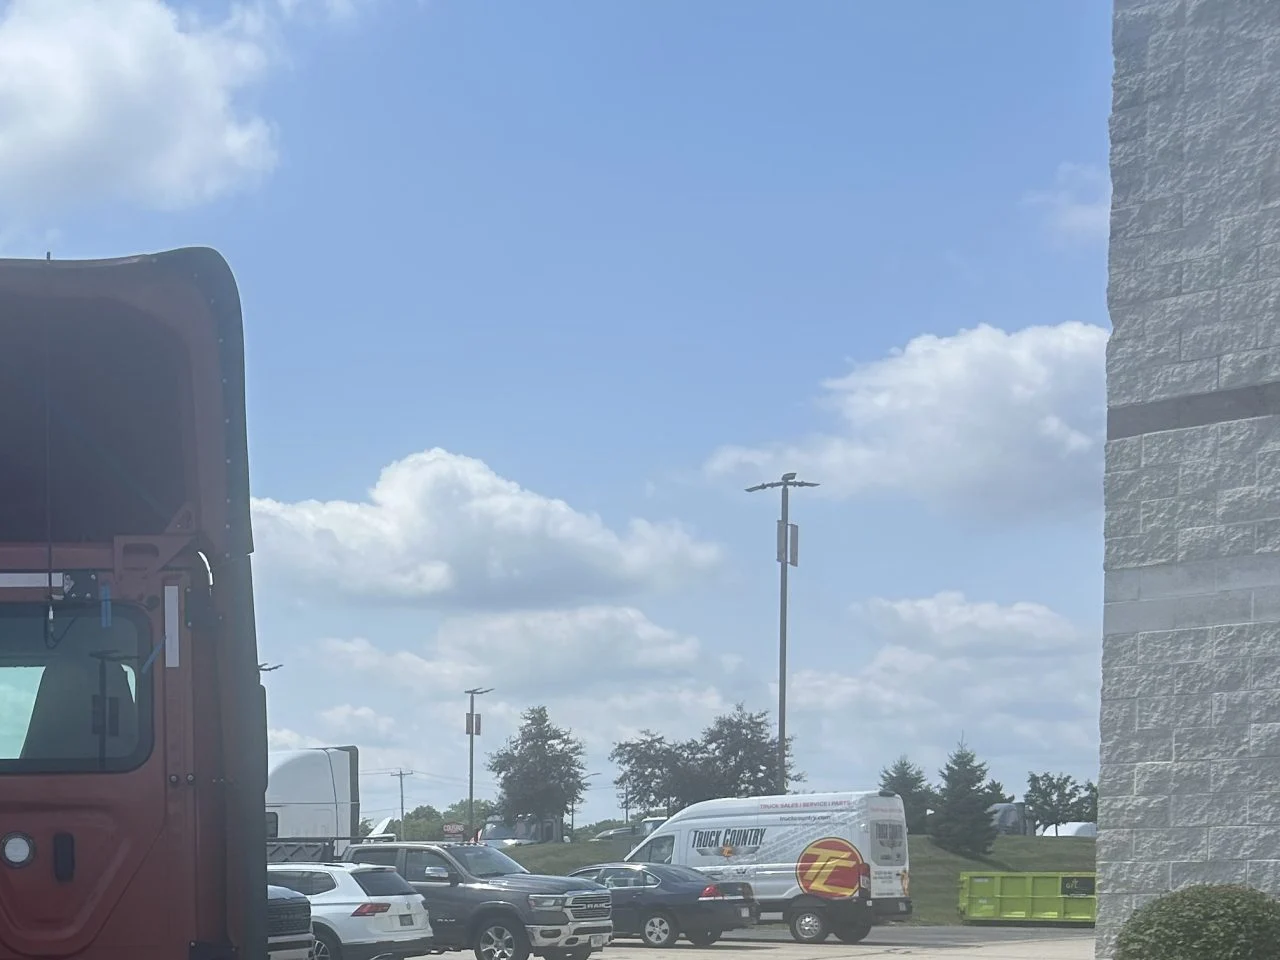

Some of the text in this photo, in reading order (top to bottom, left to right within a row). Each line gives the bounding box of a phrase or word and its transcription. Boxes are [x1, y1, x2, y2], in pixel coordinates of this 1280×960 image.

[443, 824, 464, 832] COUSINS
[692, 828, 767, 848] TRUCK COUNTRY
